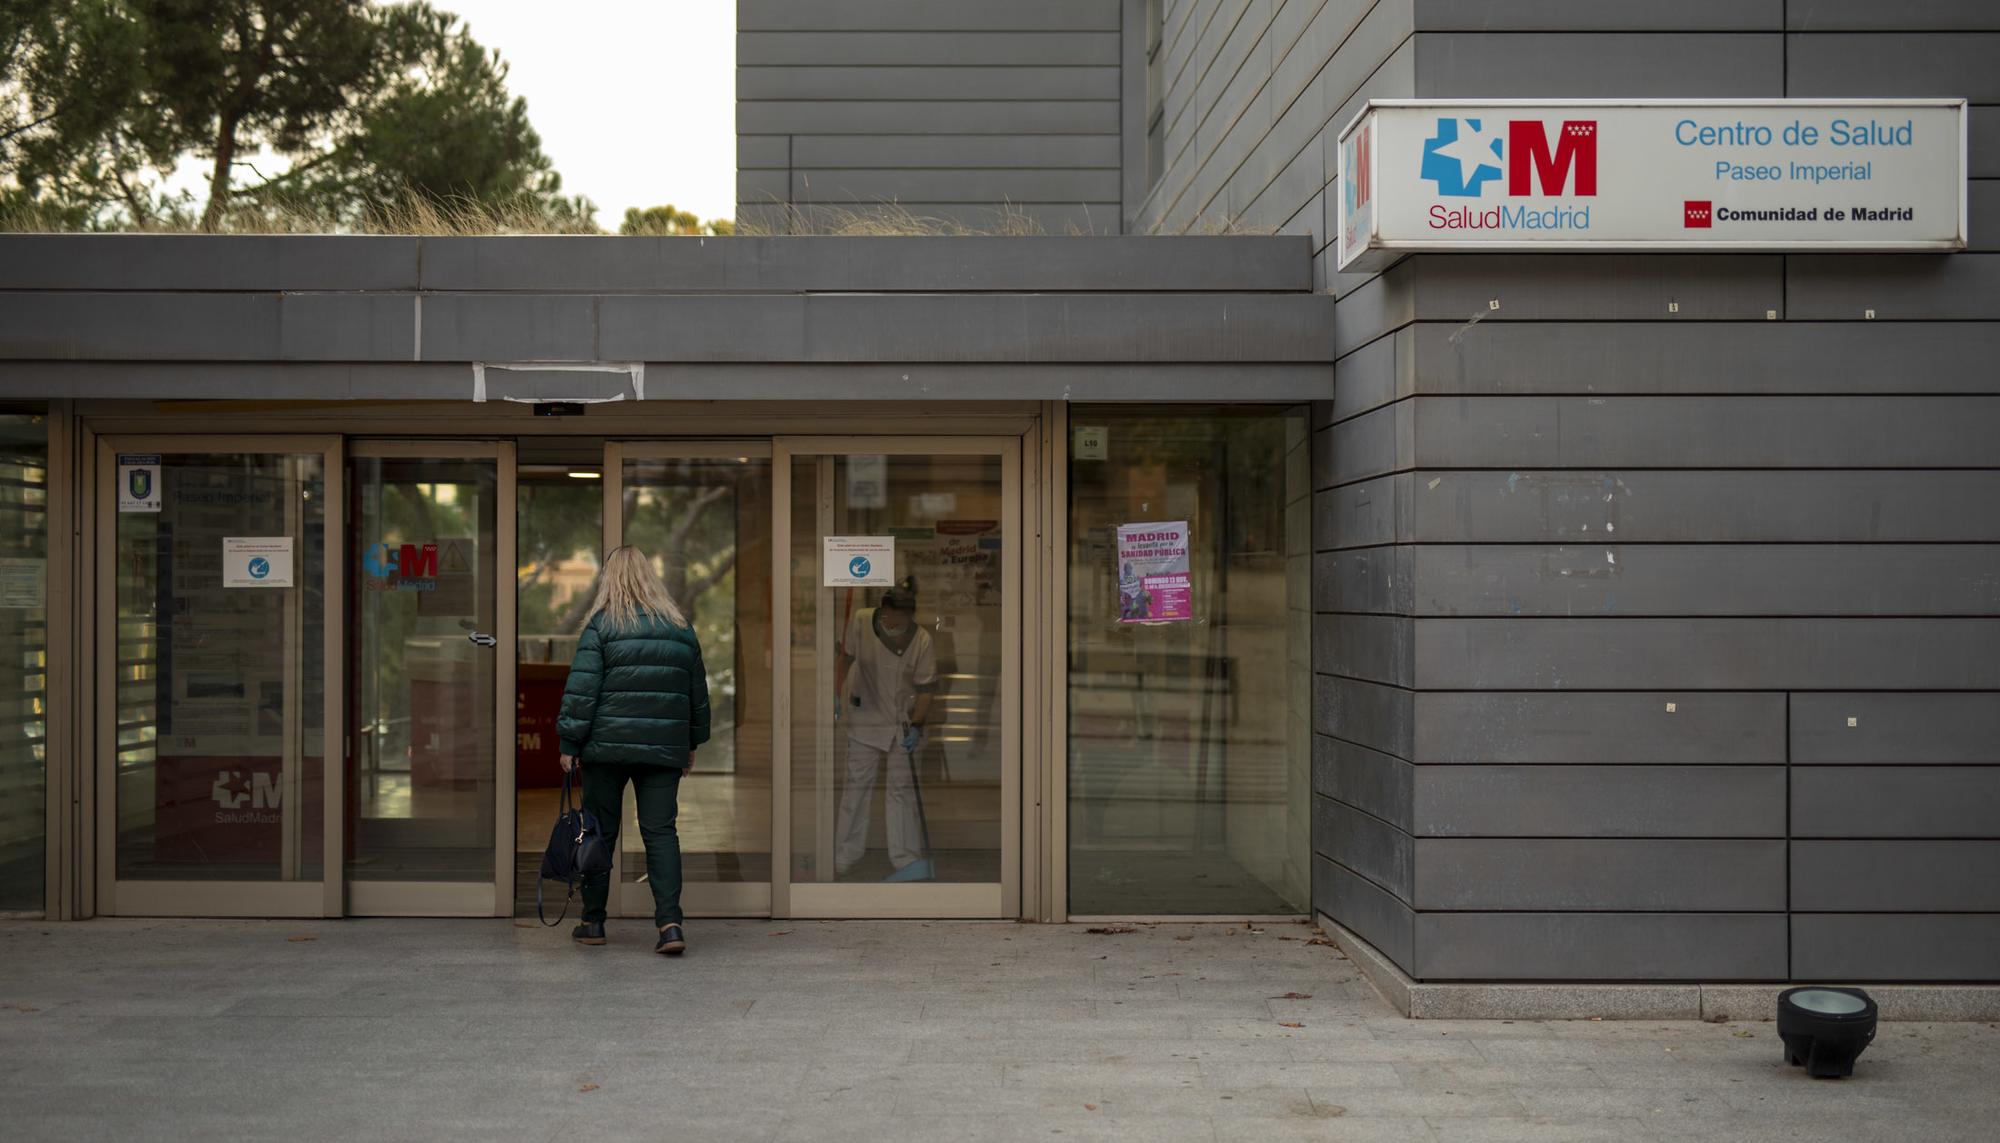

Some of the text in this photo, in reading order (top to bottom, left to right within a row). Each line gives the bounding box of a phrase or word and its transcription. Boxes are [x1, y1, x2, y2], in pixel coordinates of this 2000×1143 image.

[1676, 119, 1913, 146] Centro de Salud
[1509, 120, 1597, 196] M
[1715, 160, 1871, 184] Paseo Imperial
[1428, 205, 1590, 230] SaludMadrid
[1717, 207, 1914, 222] Comunidad de Madrid
[1126, 533, 1179, 542] MADRID
[400, 544, 438, 577] M
[1121, 550, 1153, 558] SANIDAD
